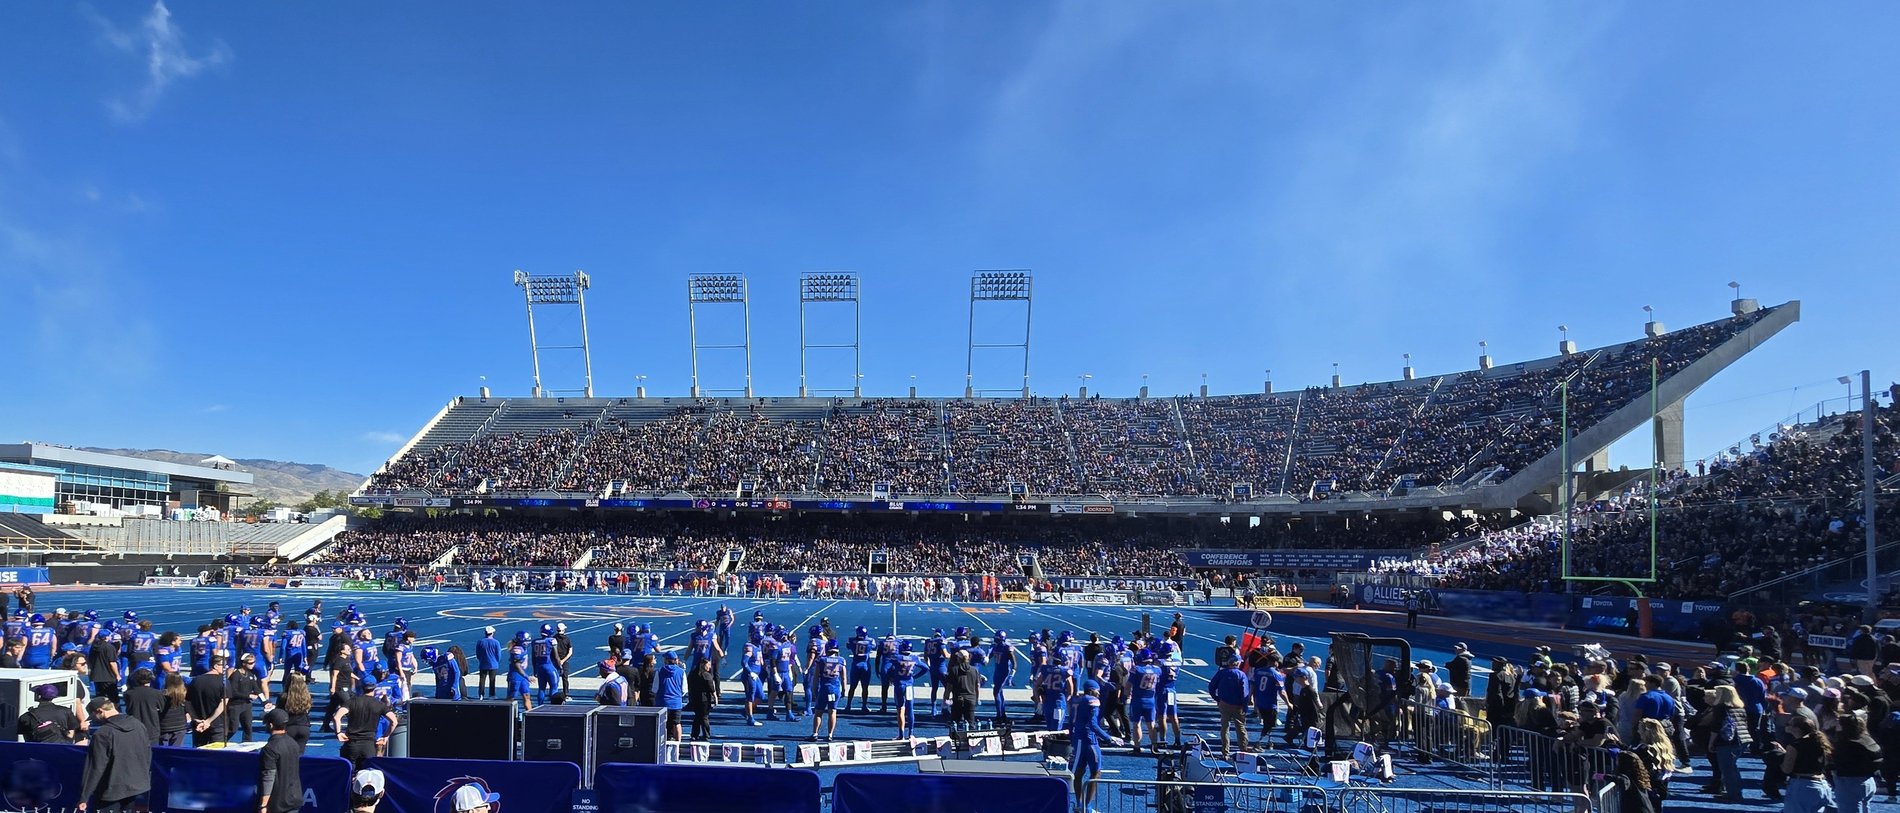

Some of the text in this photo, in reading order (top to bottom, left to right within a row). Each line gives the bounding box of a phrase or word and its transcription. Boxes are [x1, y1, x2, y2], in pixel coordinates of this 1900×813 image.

[0, 572, 18, 582] SE
[32, 632, 50, 646] 64
[290, 635, 303, 647] 48
[1810, 636, 1832, 646] STAND
[1044, 674, 1062, 690] 42
[1259, 676, 1267, 691] 8
